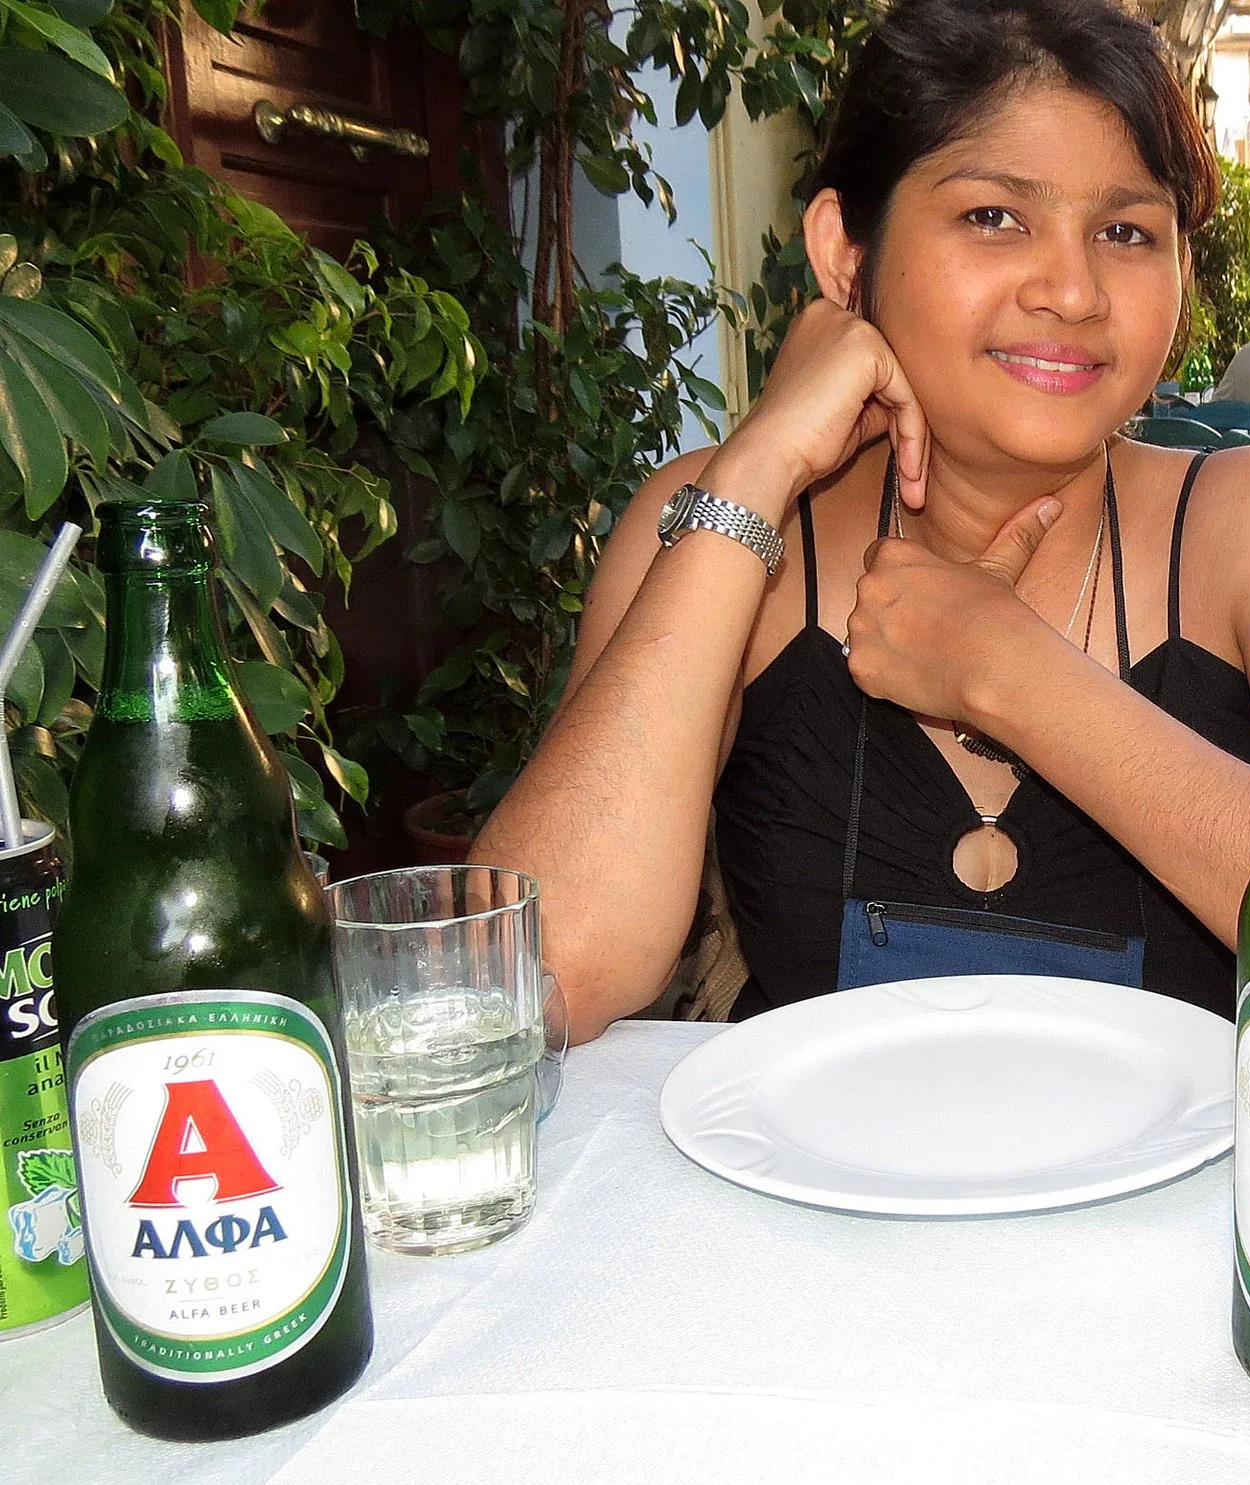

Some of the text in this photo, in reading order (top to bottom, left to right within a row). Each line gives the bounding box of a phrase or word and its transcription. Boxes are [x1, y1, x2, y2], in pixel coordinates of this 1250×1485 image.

[0, 892, 42, 913] iene
[163, 1047, 216, 1075] 1961
[131, 1205, 288, 1259] ΑΛΦΑ
[169, 1299, 262, 1320] ALFA BEER
[134, 1313, 308, 1361] TRADITIONALLY GREEK
